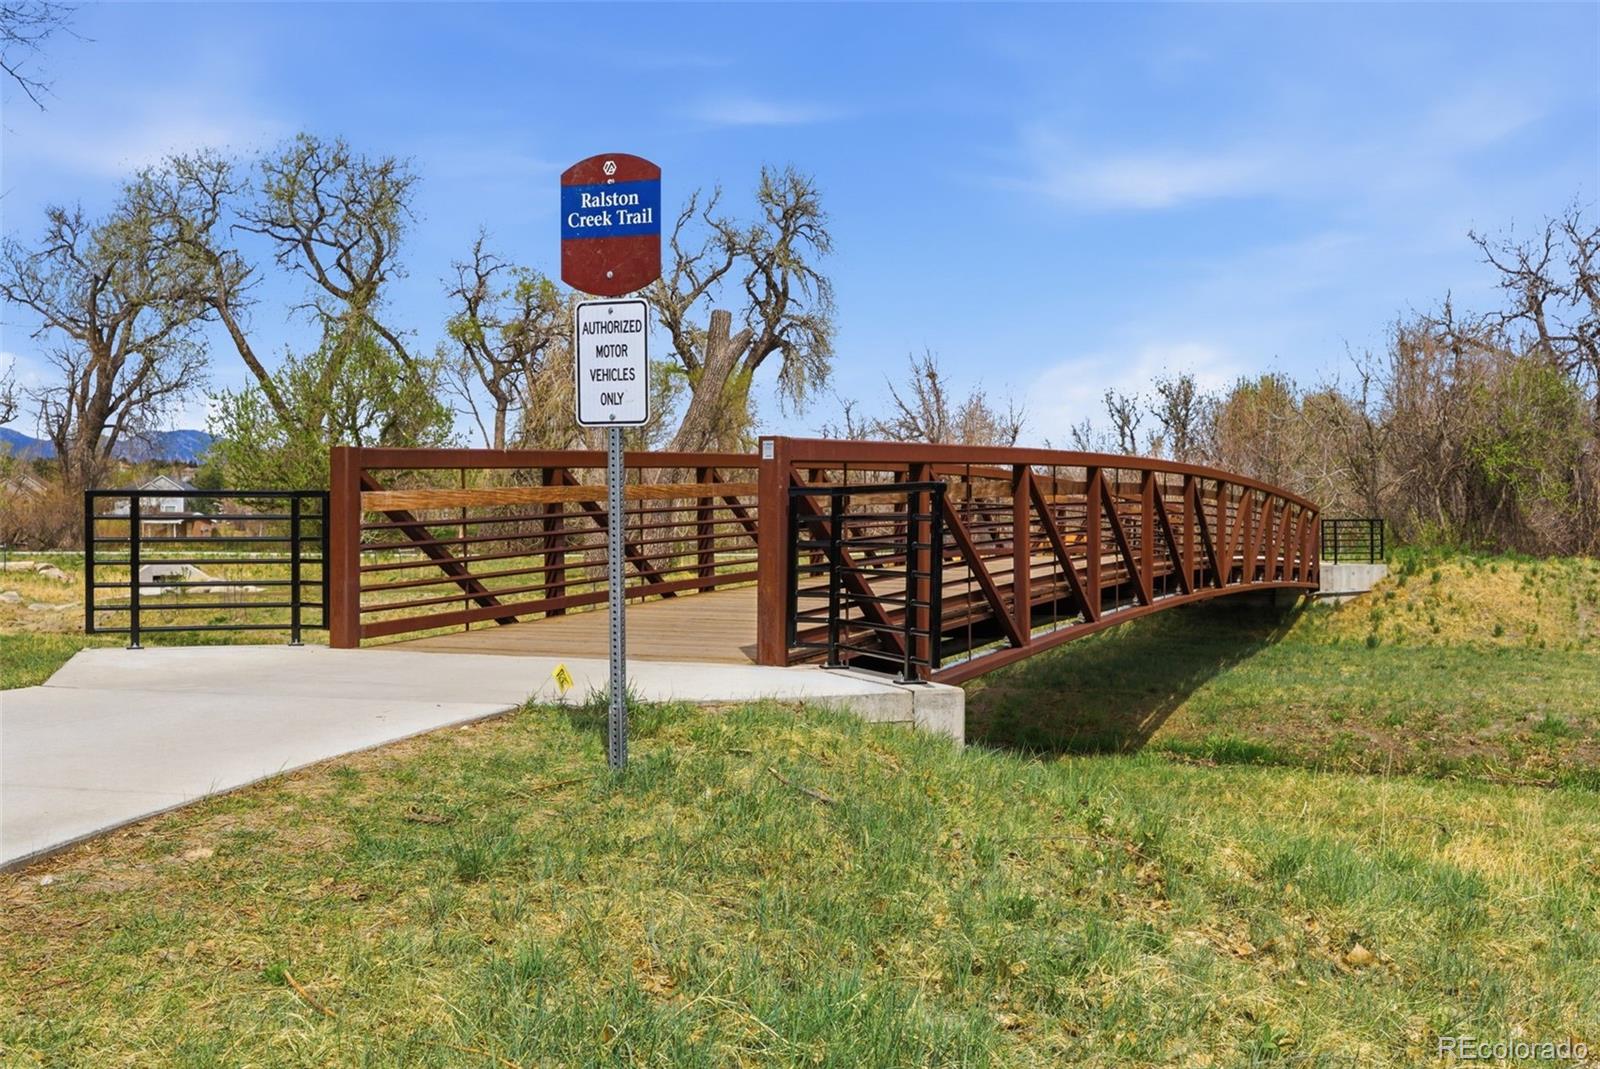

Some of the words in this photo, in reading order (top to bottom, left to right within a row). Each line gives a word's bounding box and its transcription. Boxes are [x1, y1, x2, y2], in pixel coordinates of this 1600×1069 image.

[581, 191, 640, 209] Ralston
[568, 210, 613, 228] Creek
[616, 207, 653, 225] Trail
[582, 319, 643, 335] AUTHORIZED
[595, 344, 628, 358] MOTOR
[589, 367, 636, 382] VEHICLES
[600, 391, 625, 406] ONLY
